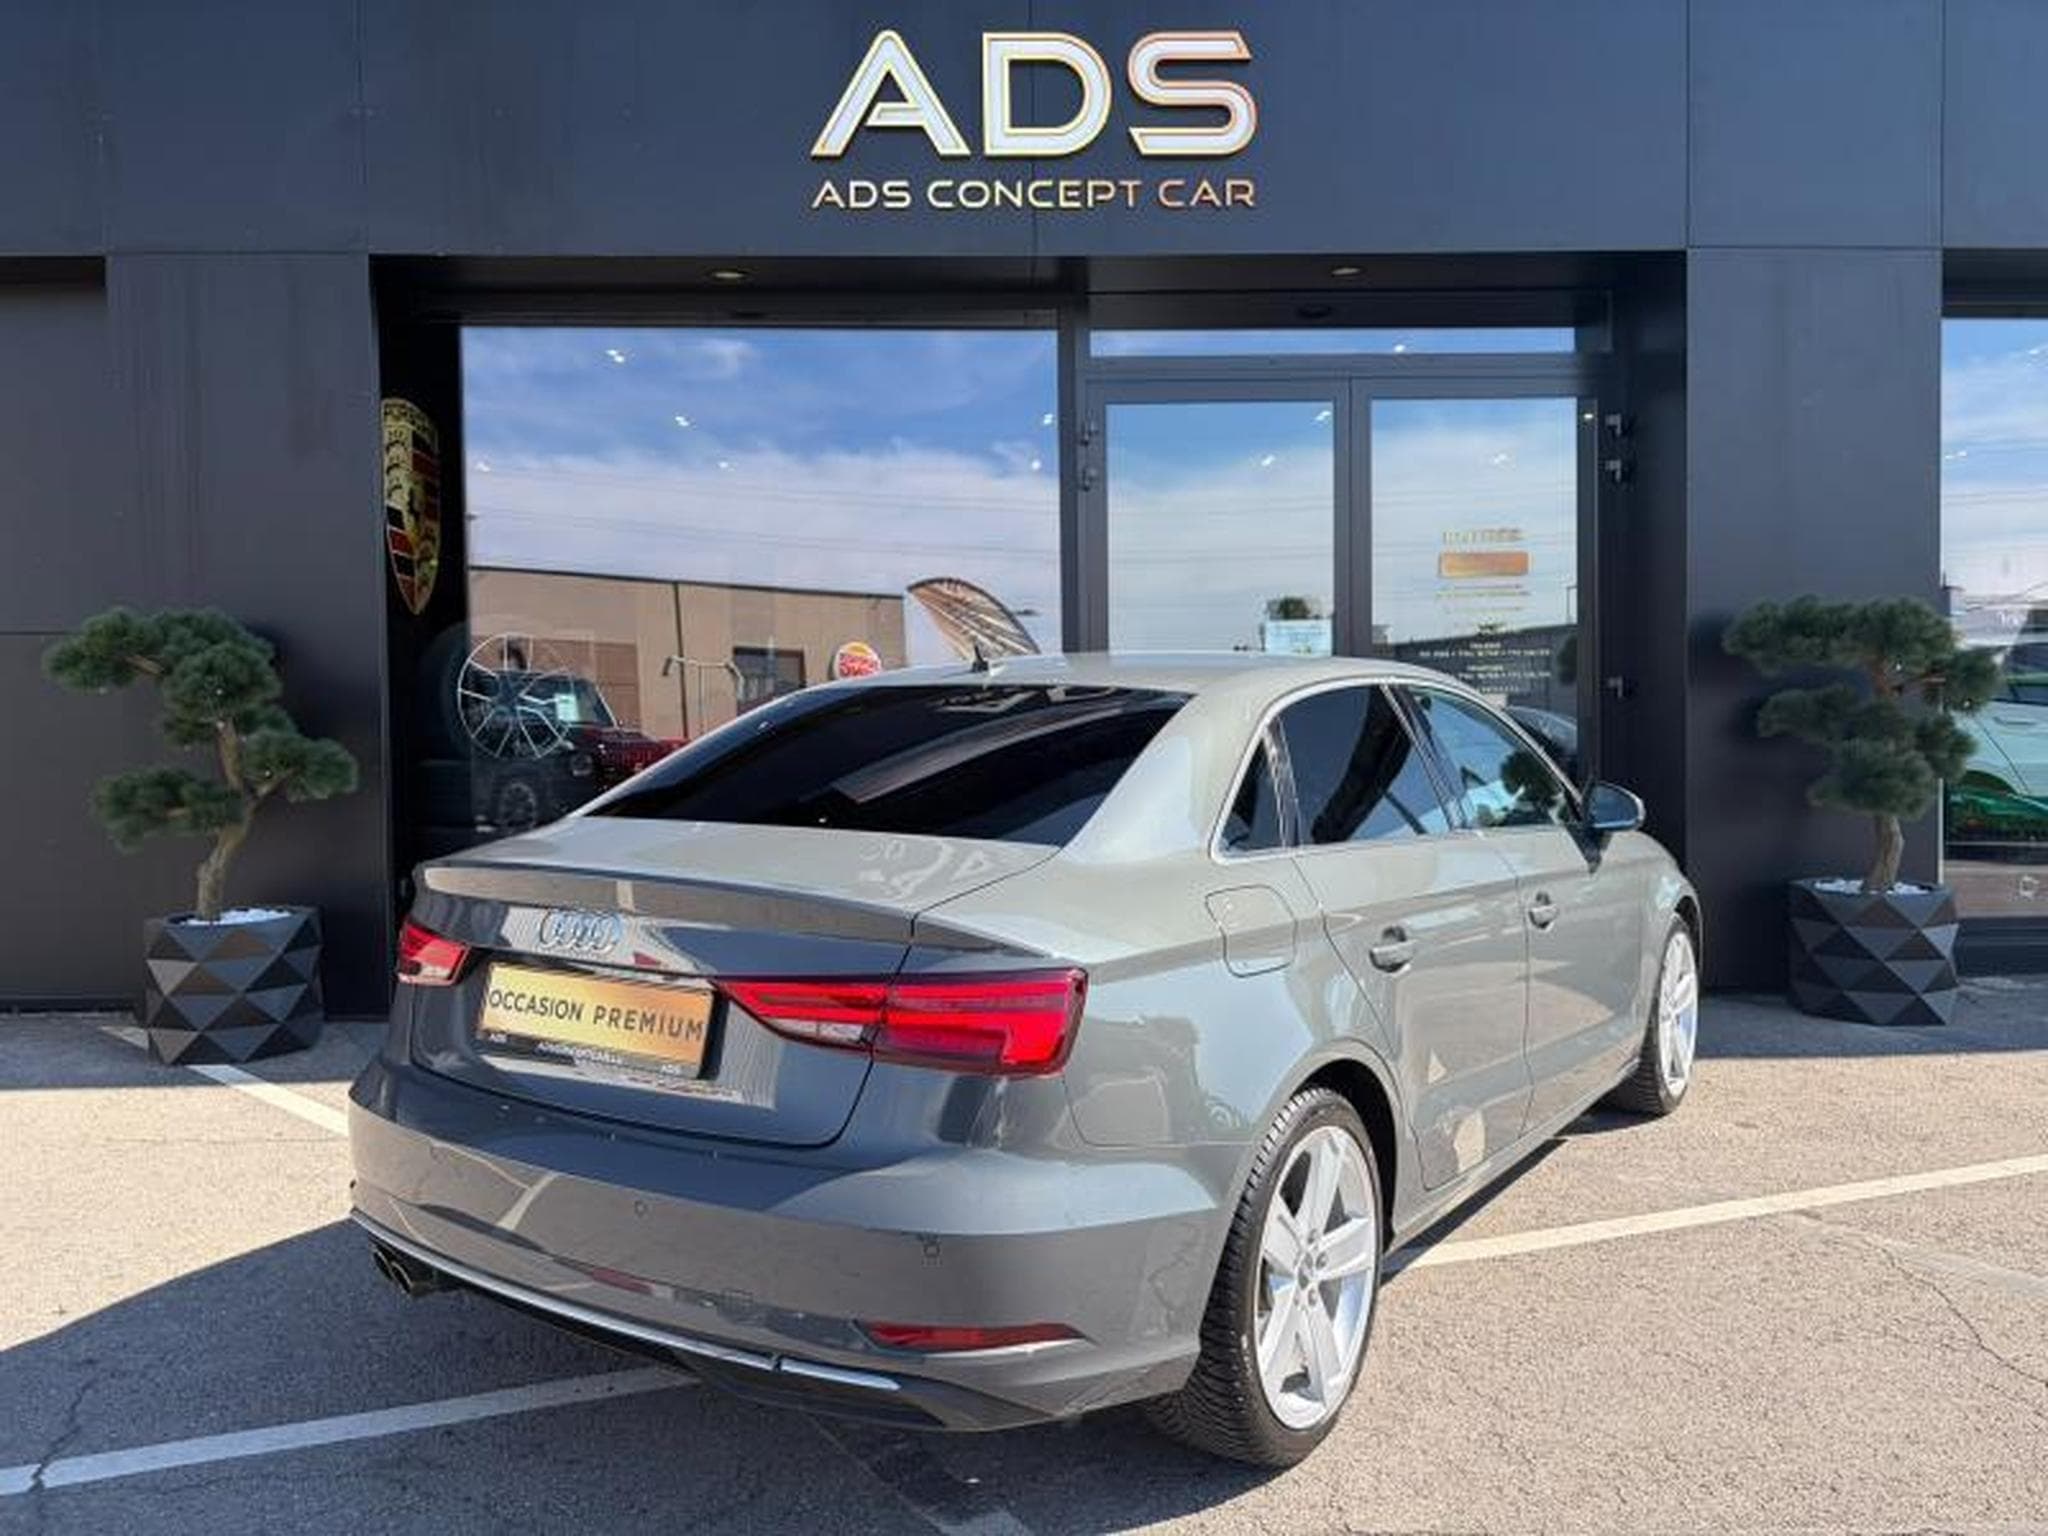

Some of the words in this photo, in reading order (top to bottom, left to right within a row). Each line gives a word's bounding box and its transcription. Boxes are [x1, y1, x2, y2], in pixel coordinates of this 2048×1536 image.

[810, 29, 1258, 157] ADS
[811, 180, 912, 210] ADS
[927, 180, 1142, 210] CONCEPT
[1157, 180, 1256, 210] CAR
[488, 989, 585, 1024] OCCASION
[592, 1004, 705, 1043] PREMIUM
